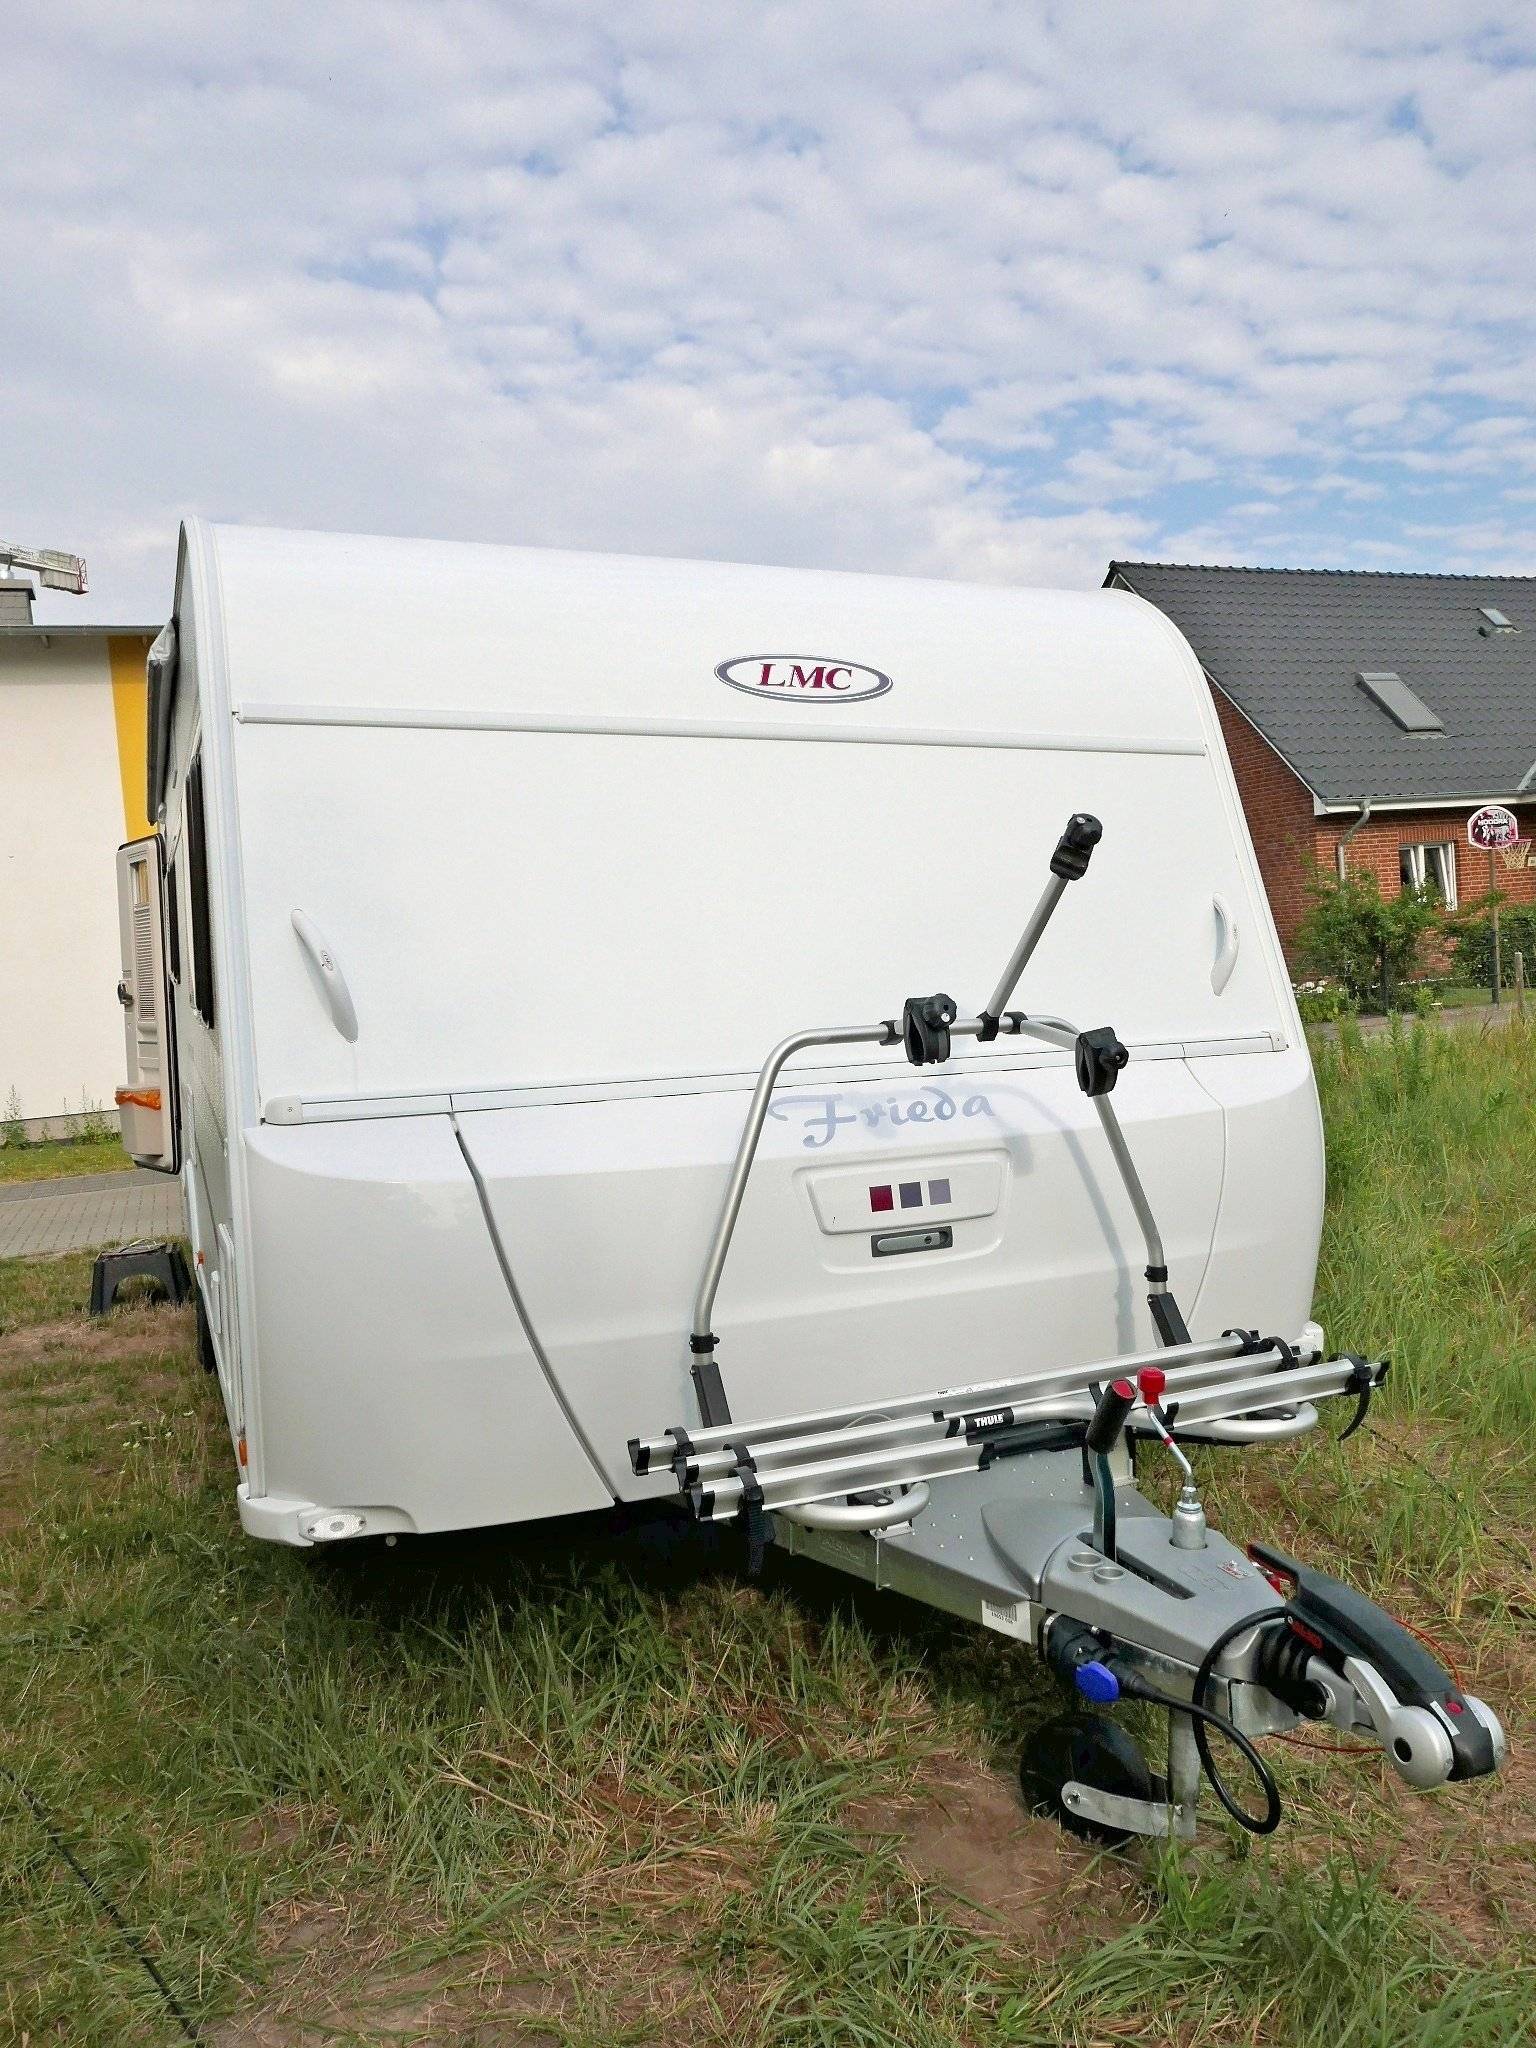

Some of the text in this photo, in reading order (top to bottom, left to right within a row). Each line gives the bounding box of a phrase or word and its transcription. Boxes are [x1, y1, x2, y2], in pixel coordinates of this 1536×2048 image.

[756, 662, 853, 691] LMC
[768, 1086, 995, 1148] Frieda
[974, 1413, 1004, 1428] THULE
